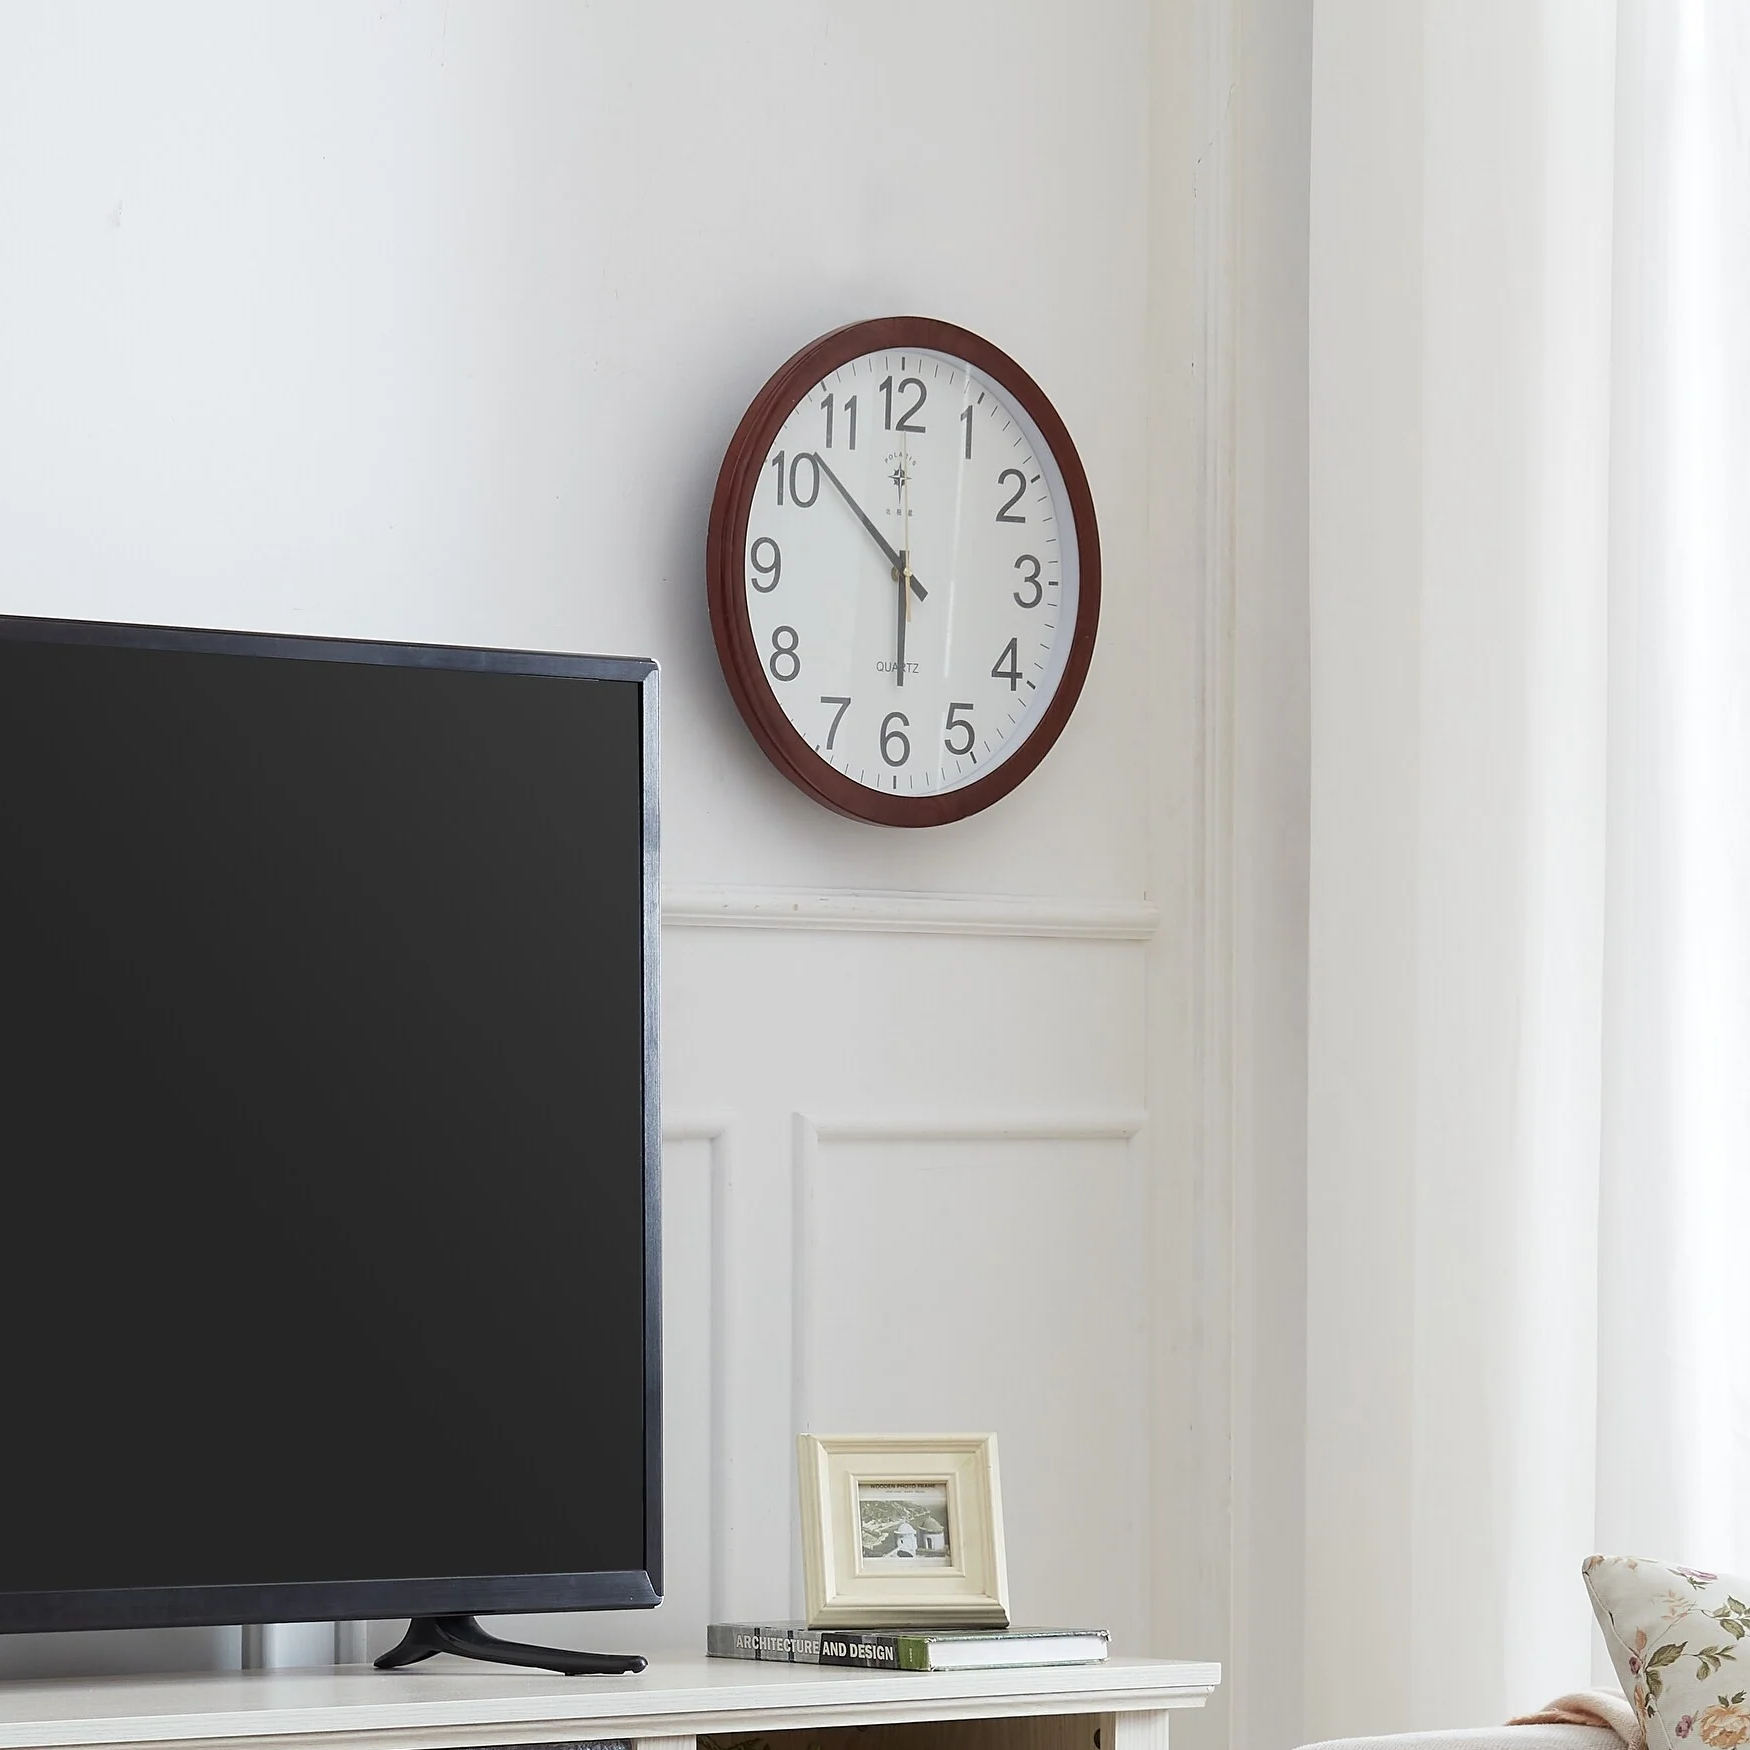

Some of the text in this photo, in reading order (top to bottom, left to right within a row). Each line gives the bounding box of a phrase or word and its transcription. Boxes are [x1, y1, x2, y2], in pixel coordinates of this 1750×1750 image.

[820, 393, 858, 451] 11
[880, 375, 928, 434] 12
[960, 405, 974, 459] 1
[772, 450, 821, 509] 10
[996, 468, 1027, 523] 2
[751, 537, 782, 594] 9
[1013, 554, 1043, 609] 3
[769, 625, 801, 682] 8
[991, 638, 1023, 691] 4
[820, 696, 851, 751] 7
[879, 711, 911, 767] 6
[944, 702, 975, 756] 5
[736, 1634, 820, 1655] ARCHITECTURE
[822, 1641, 847, 1657] AND
[850, 1643, 894, 1661] DESIGN
